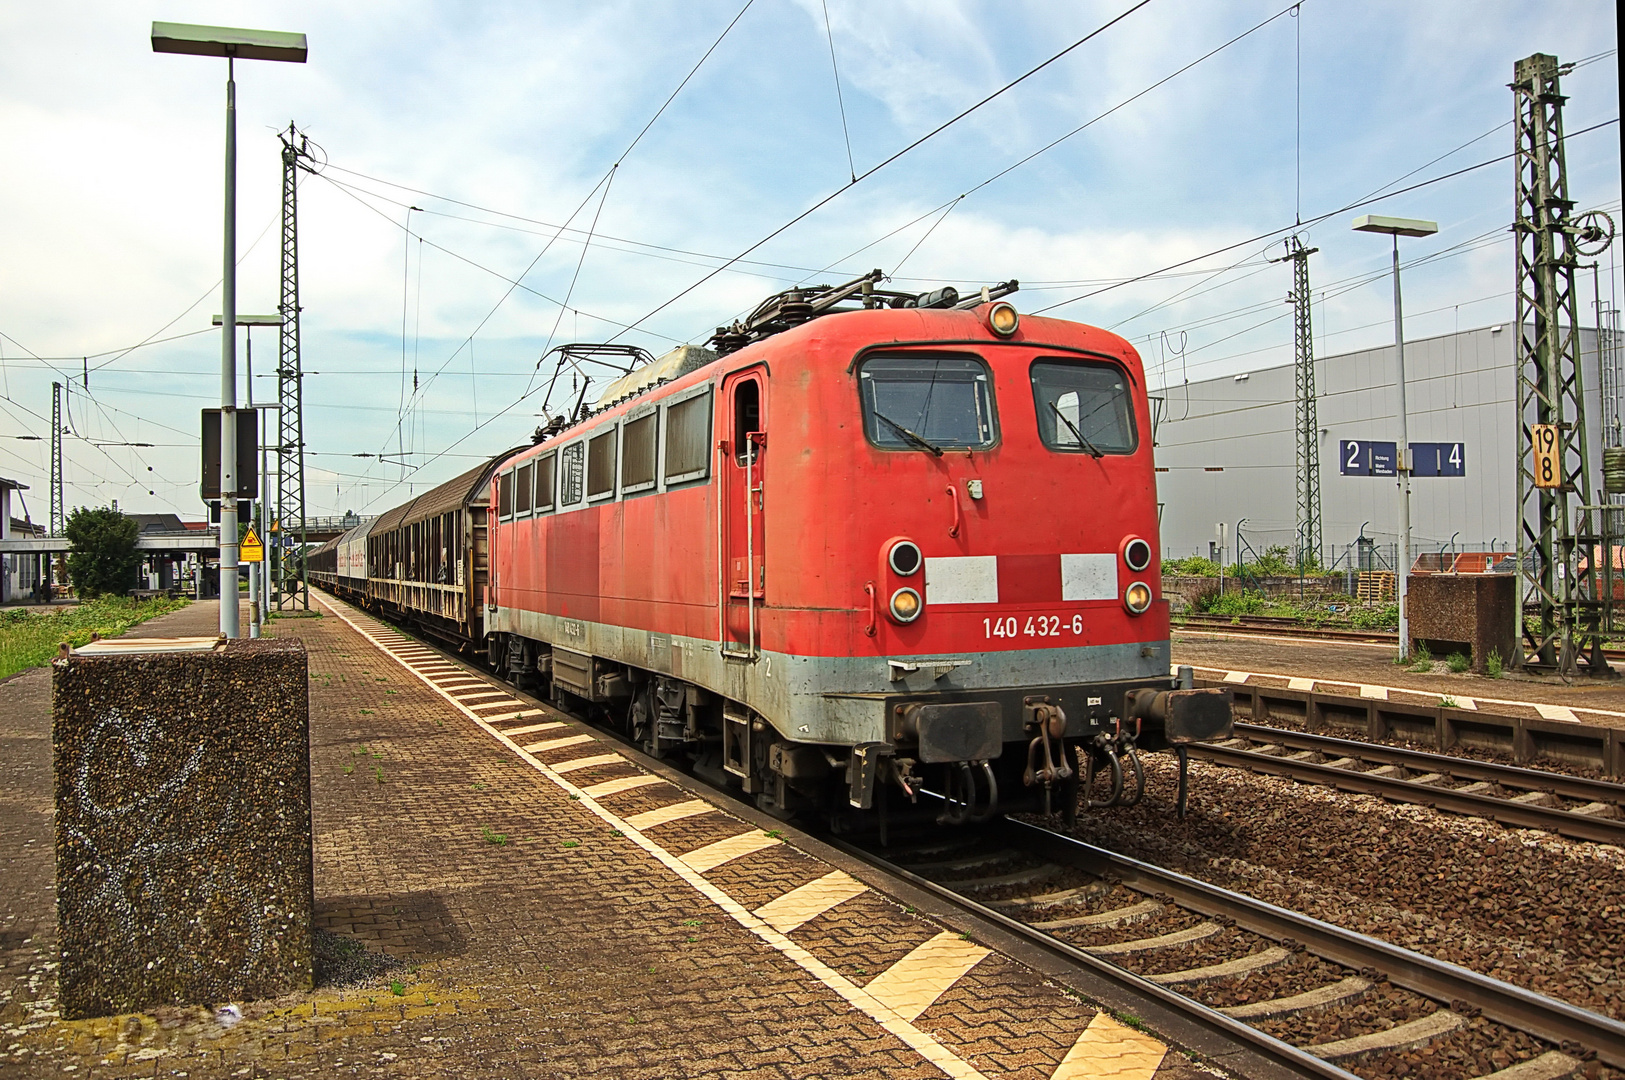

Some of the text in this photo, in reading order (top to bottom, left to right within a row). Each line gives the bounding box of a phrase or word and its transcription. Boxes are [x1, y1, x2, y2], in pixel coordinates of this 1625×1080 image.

[1535, 428, 1554, 453] 19
[1347, 441, 1359, 468] 2
[1449, 443, 1461, 469] 4
[1542, 457, 1552, 482] 8
[983, 614, 1082, 638] 140 432-6
[766, 657, 772, 677] 2
